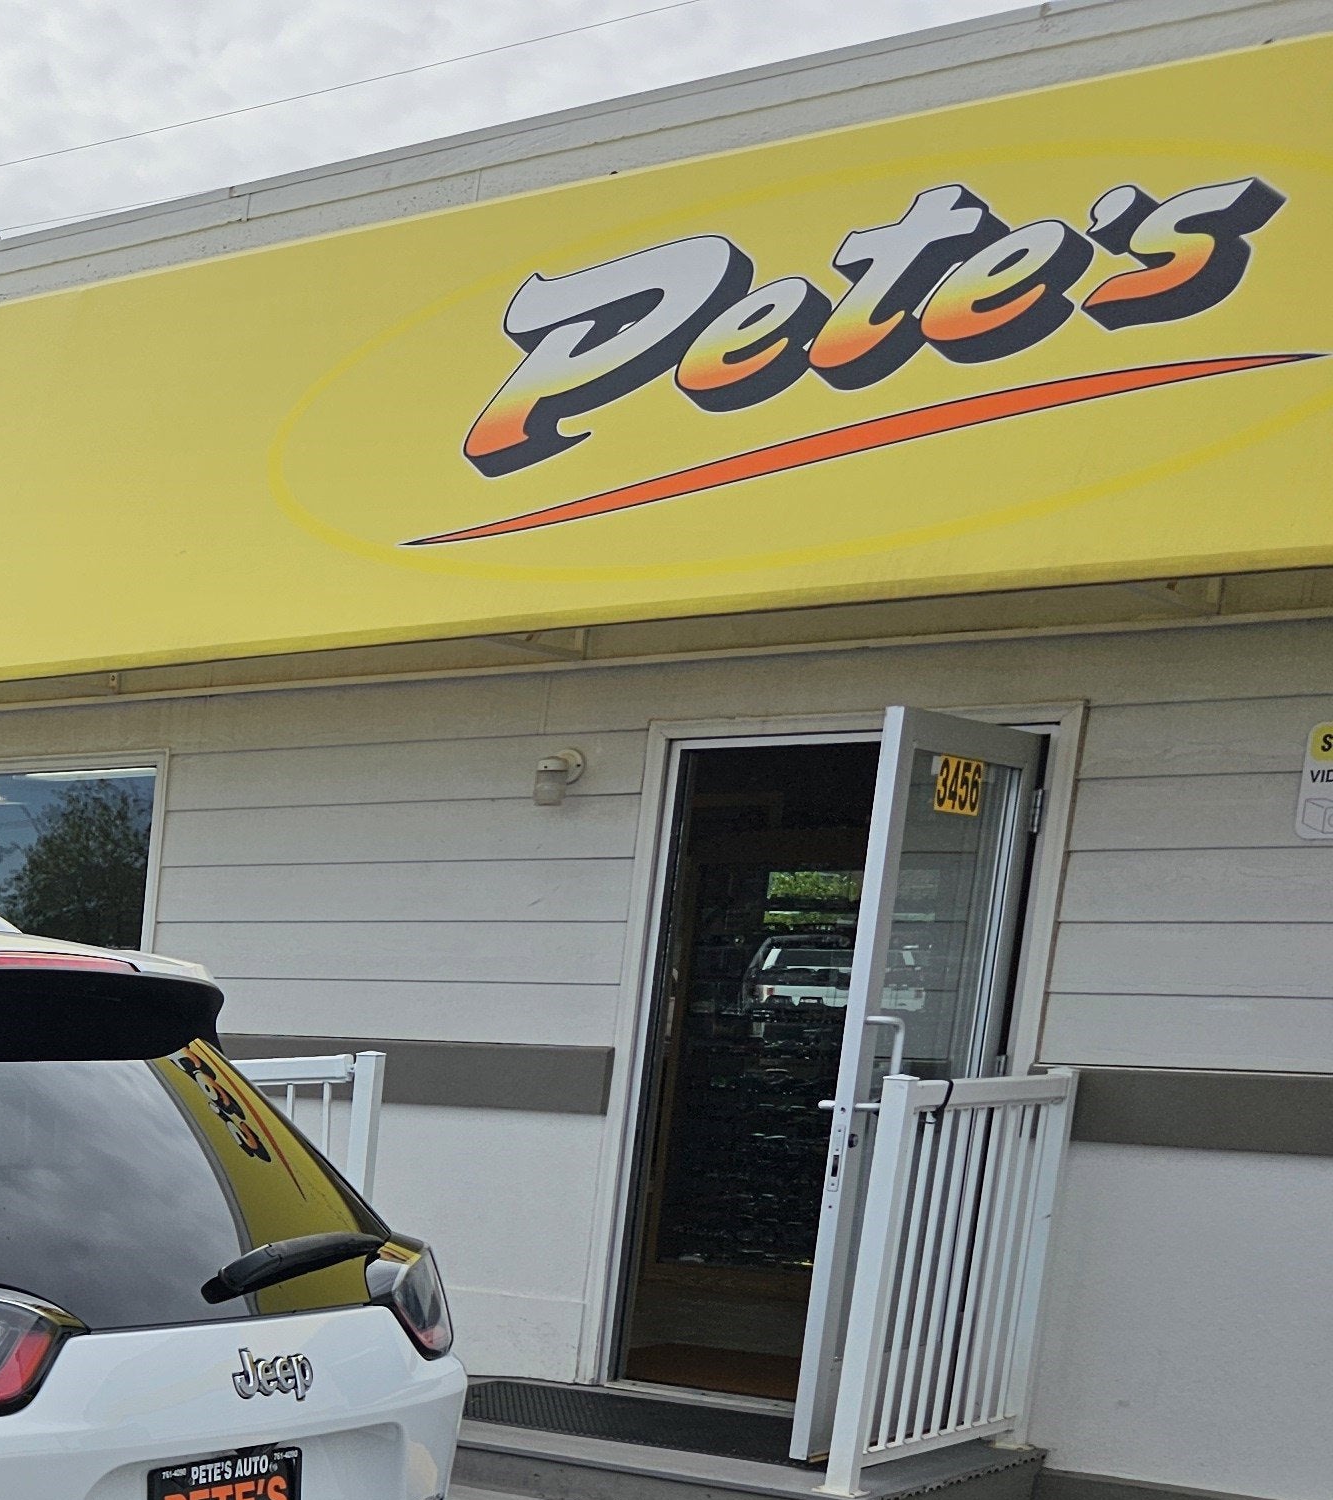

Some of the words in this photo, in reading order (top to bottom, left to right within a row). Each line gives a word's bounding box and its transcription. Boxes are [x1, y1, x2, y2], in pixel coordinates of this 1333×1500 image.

[462, 176, 1288, 477] Pete's
[936, 757, 982, 813] 3456
[232, 1347, 313, 1401] Jeep
[190, 1460, 233, 1486] PETE'S
[235, 1454, 269, 1479] AUTO
